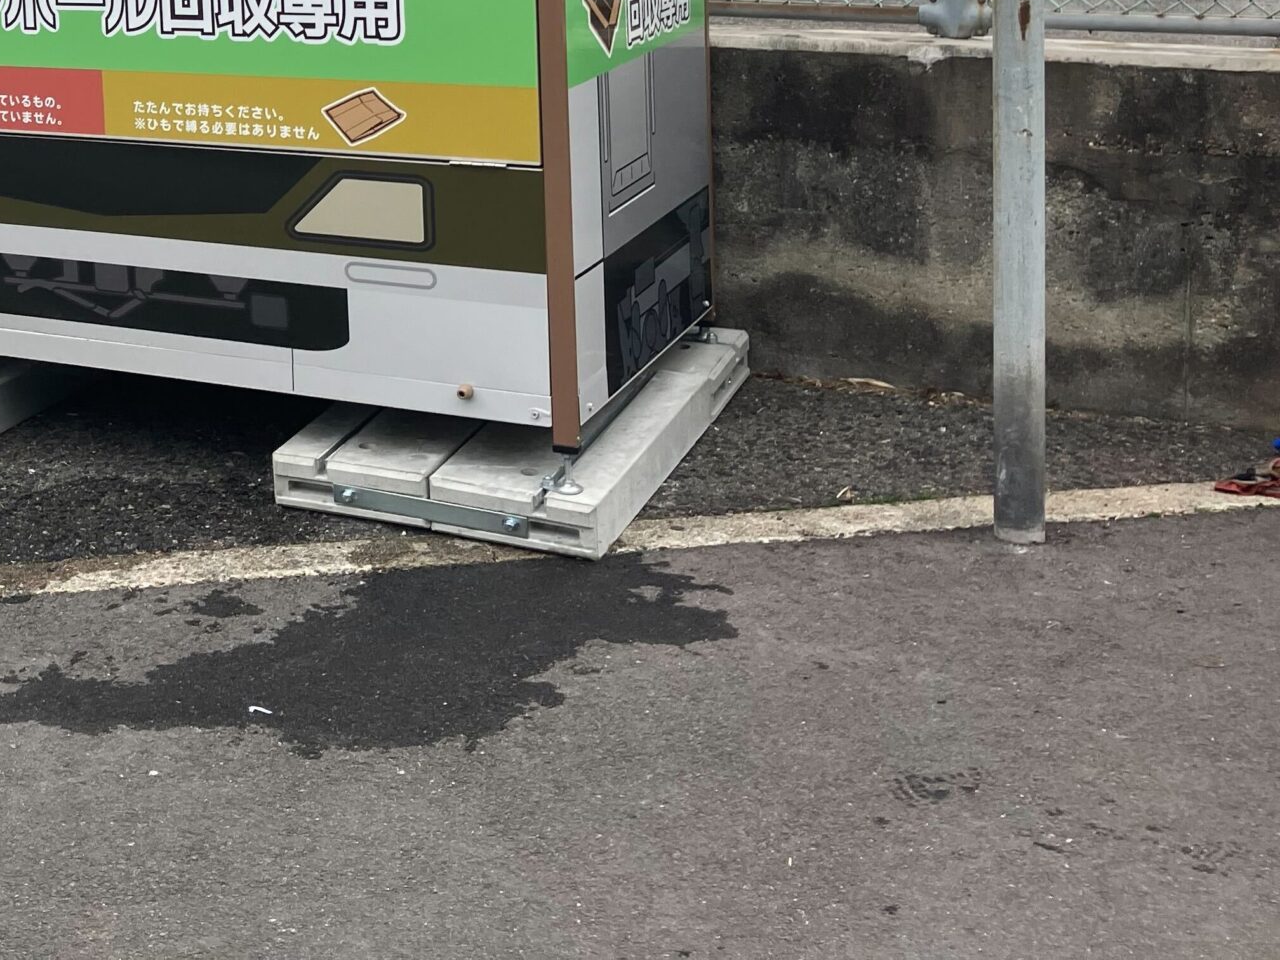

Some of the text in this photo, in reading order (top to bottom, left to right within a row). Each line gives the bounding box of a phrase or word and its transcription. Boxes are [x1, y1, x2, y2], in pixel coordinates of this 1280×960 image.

[133, 100, 285, 122] たたんでお持ちください。
[134, 117, 320, 140] ※ひもで縛る必要はありません
